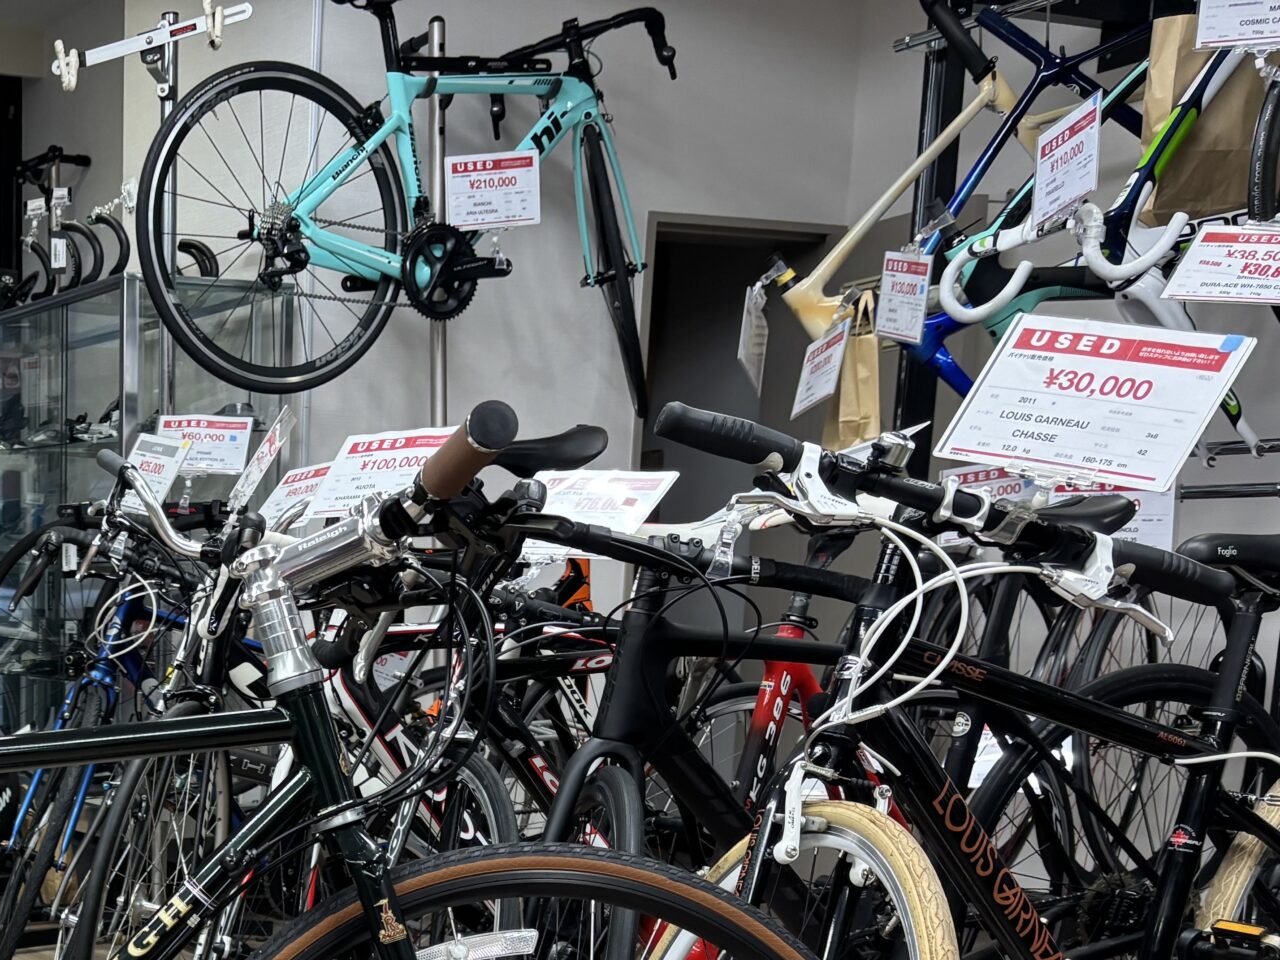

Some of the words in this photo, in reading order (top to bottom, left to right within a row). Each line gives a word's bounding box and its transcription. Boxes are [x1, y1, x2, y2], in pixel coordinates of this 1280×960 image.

[1240, 18, 1270, 27] COSMIC
[1045, 130, 1070, 154] USED
[331, 145, 369, 181] Bianchi
[457, 160, 493, 171] USED
[469, 176, 517, 190] ¥210,000
[1238, 235, 1280, 243] USED
[887, 259, 908, 272] USED
[1030, 331, 1121, 354] USED
[1043, 367, 1153, 400] ¥30,000
[1018, 396, 1037, 404] 2011
[999, 410, 1033, 422] LOUIS
[1034, 415, 1090, 430] GARNEAU
[1012, 429, 1058, 443] CHASSE
[358, 438, 406, 451] USED
[1001, 444, 1017, 452] 12.0
[360, 455, 428, 472] ¥100,000
[1081, 455, 1113, 467] 160-175
[287, 470, 314, 483] USED
[298, 525, 348, 551] Raleigh
[765, 670, 791, 746] 386
[933, 778, 998, 877] LOUIS
